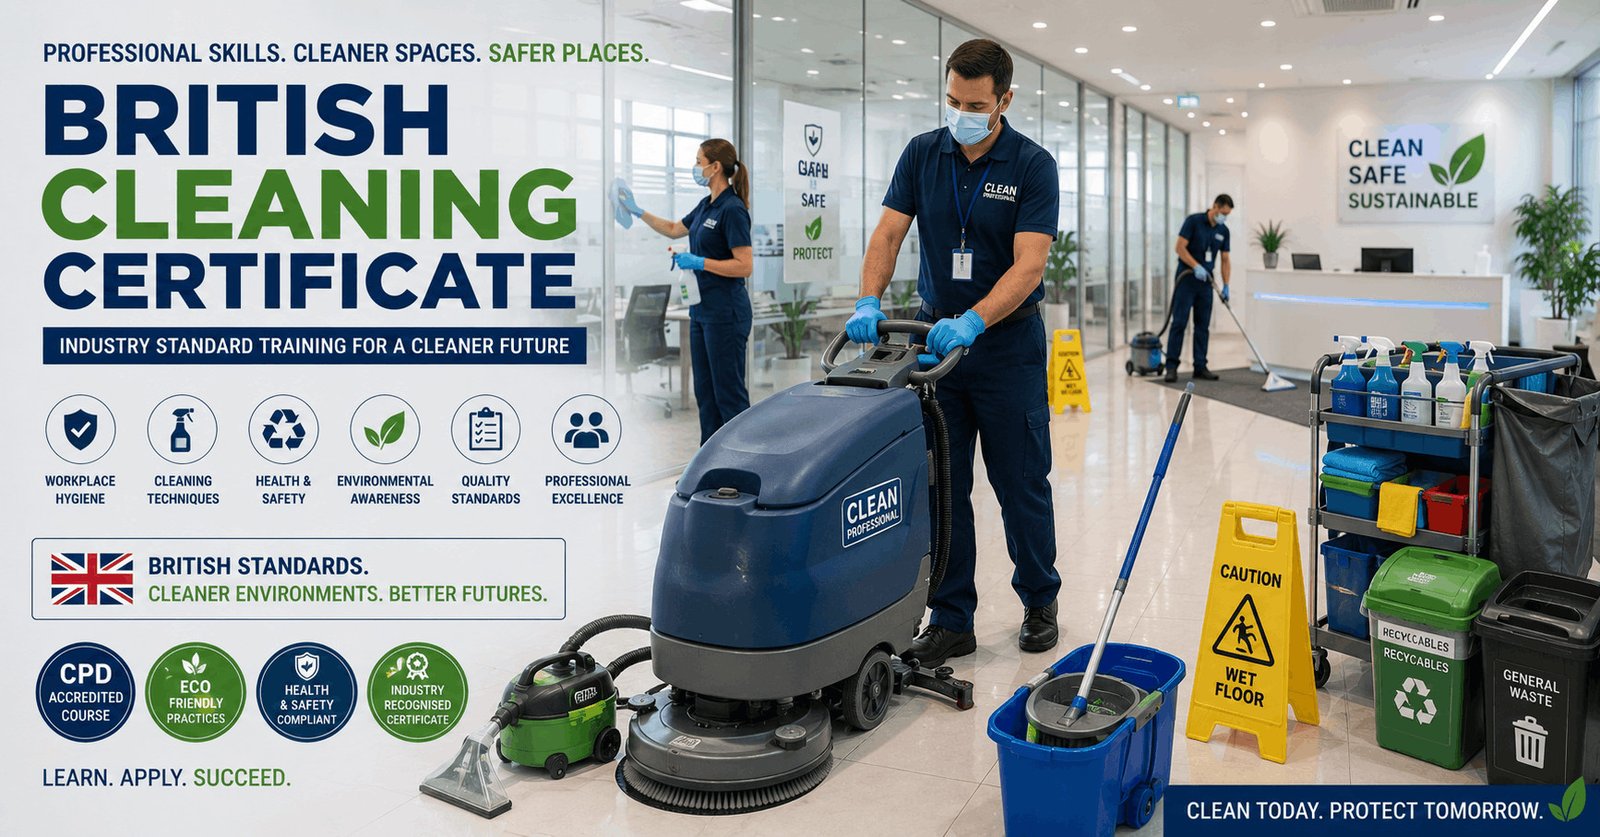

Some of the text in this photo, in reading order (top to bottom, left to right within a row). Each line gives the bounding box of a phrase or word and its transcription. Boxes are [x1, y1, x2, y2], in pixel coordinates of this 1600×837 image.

[1349, 139, 1423, 158] CLEAN
[1349, 166, 1406, 184] SAFE
[801, 193, 826, 208] SAFE
[984, 182, 1017, 197] CLEAN
[1349, 192, 1478, 209] SUSTAINABLE
[793, 247, 833, 260] PROTECT
[847, 486, 897, 524] CLEAN
[847, 509, 899, 540] PROFESSIONAL
[1220, 564, 1282, 589] CAUTION
[1384, 647, 1449, 673] RECYCABLES
[1225, 666, 1257, 687] WET
[1503, 669, 1560, 694] GENERAL
[1215, 682, 1264, 708] FLOOR
[1510, 685, 1552, 708] WASTE
